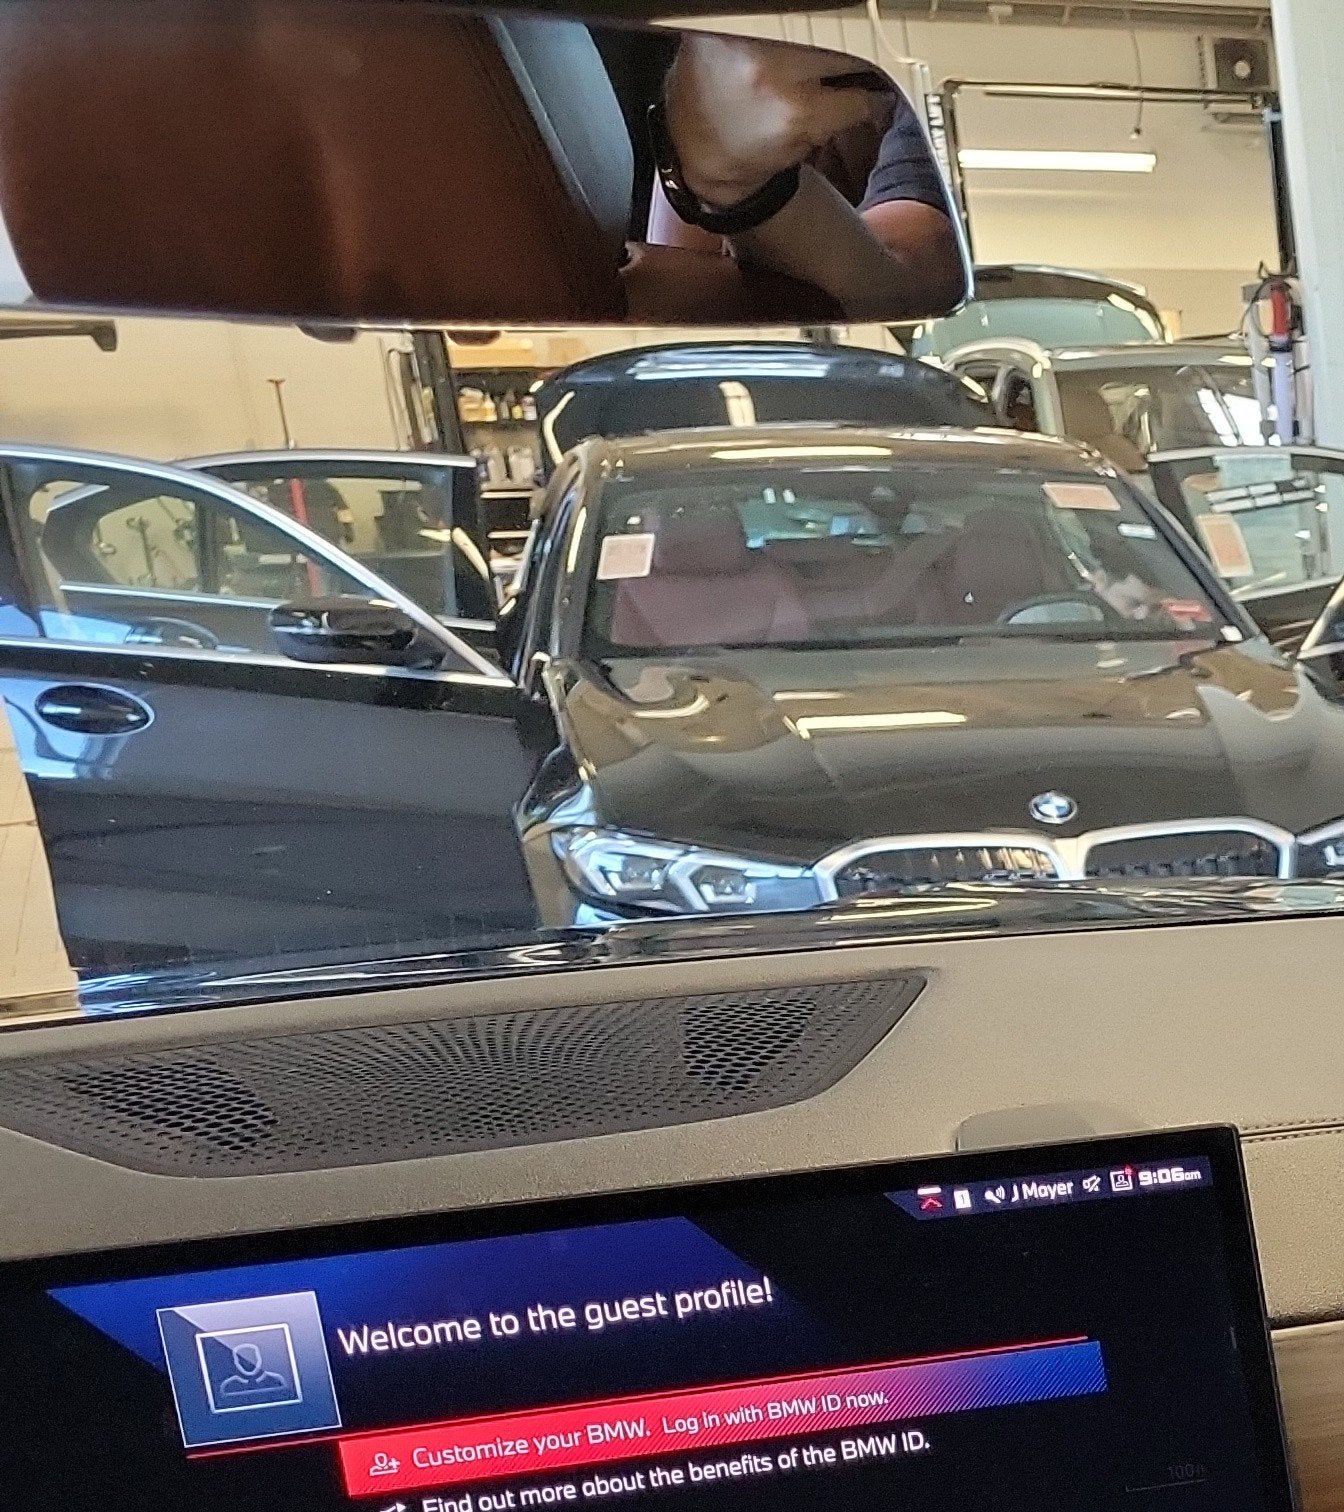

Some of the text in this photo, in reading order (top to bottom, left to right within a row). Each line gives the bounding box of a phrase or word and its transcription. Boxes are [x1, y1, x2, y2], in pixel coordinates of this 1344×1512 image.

[1011, 1184, 1019, 1203] J
[1021, 1180, 1074, 1200] Mayer
[337, 1275, 773, 1355] Welcome to the guest profile!
[412, 1390, 889, 1469] Customize your BMW. Log in with BMW ID now.
[478, 1489, 516, 1512] out
[520, 1483, 577, 1506] more
[582, 1470, 645, 1498] about
[648, 1465, 685, 1488] the
[688, 1453, 774, 1482] benefits
[777, 1447, 799, 1470] of
[801, 1443, 837, 1467] the
[840, 1434, 896, 1461] BMW
[900, 1430, 931, 1452] ID.
